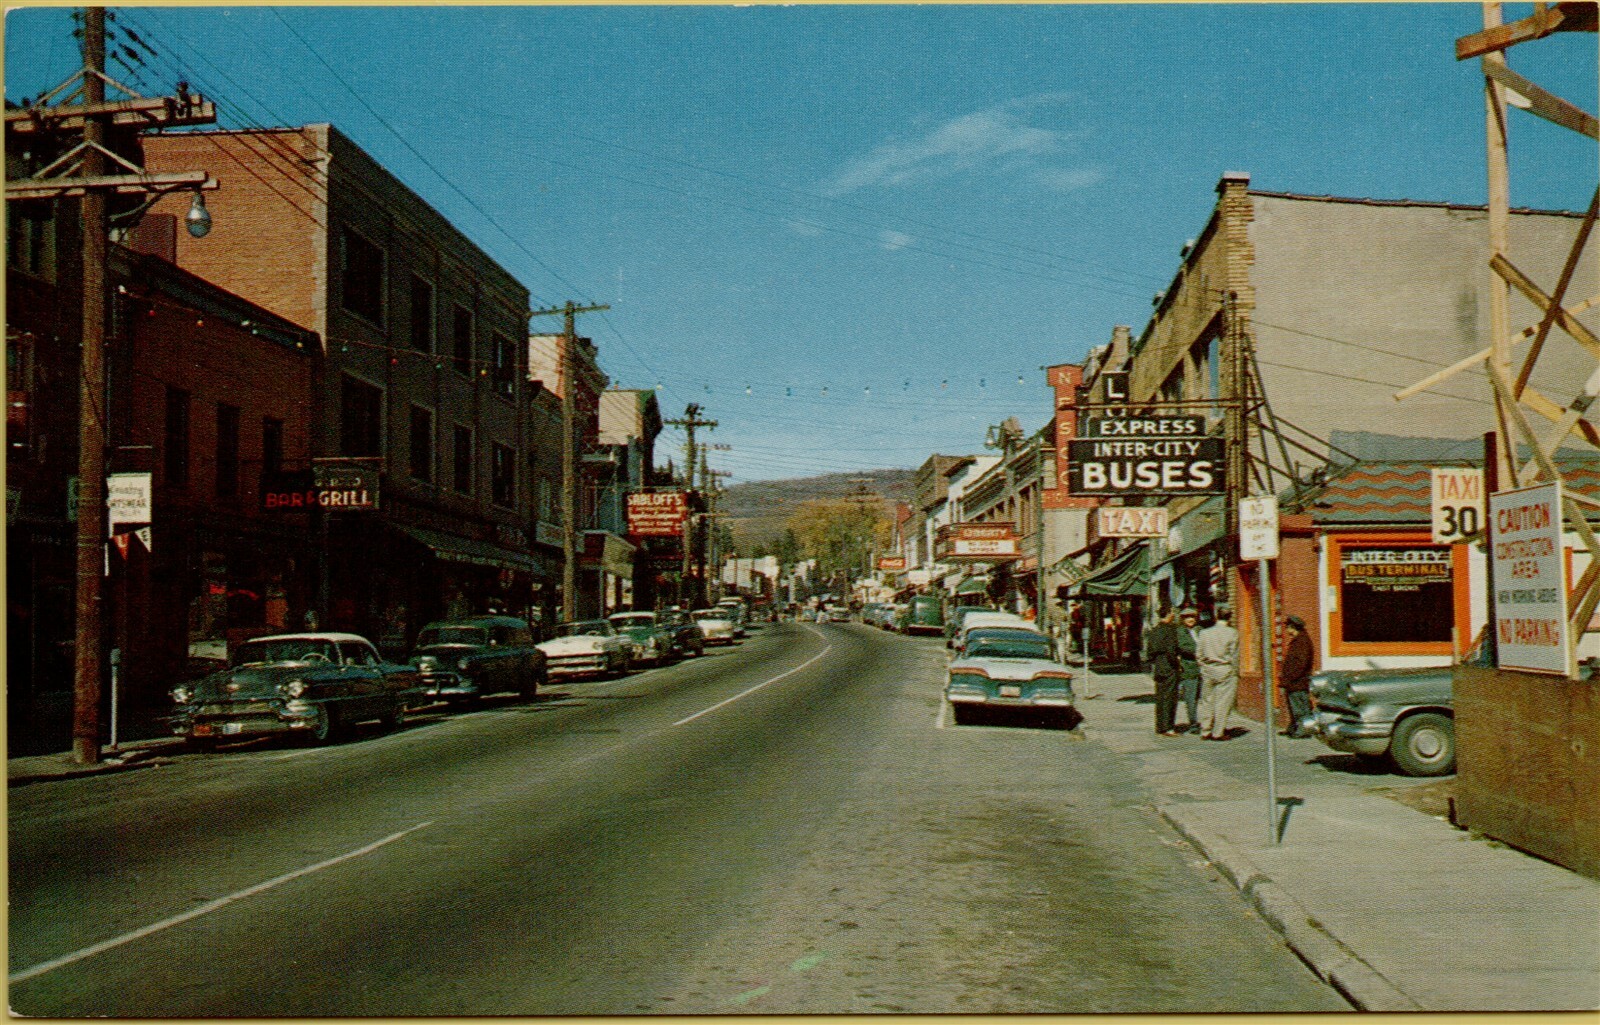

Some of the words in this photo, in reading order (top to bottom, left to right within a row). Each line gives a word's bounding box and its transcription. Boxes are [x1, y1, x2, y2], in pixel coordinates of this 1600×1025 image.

[1101, 420, 1197, 435] EXPRESS
[1094, 441, 1200, 458] INTER-CITY
[1083, 461, 1213, 489] BUSES
[265, 492, 303, 507] BAR
[319, 489, 373, 506] GRILL
[1437, 474, 1479, 500] TAXI
[1103, 511, 1164, 533] TAXI
[1439, 505, 1478, 537] 30
[1497, 503, 1551, 534] CAUTION
[1496, 537, 1555, 560] CONSTRUCTION
[1349, 564, 1374, 576] BUS
[1379, 564, 1446, 576] TERMINAL
[1512, 560, 1540, 578] AREA
[1499, 618, 1512, 645] NO
[1514, 618, 1560, 647] PARKING
